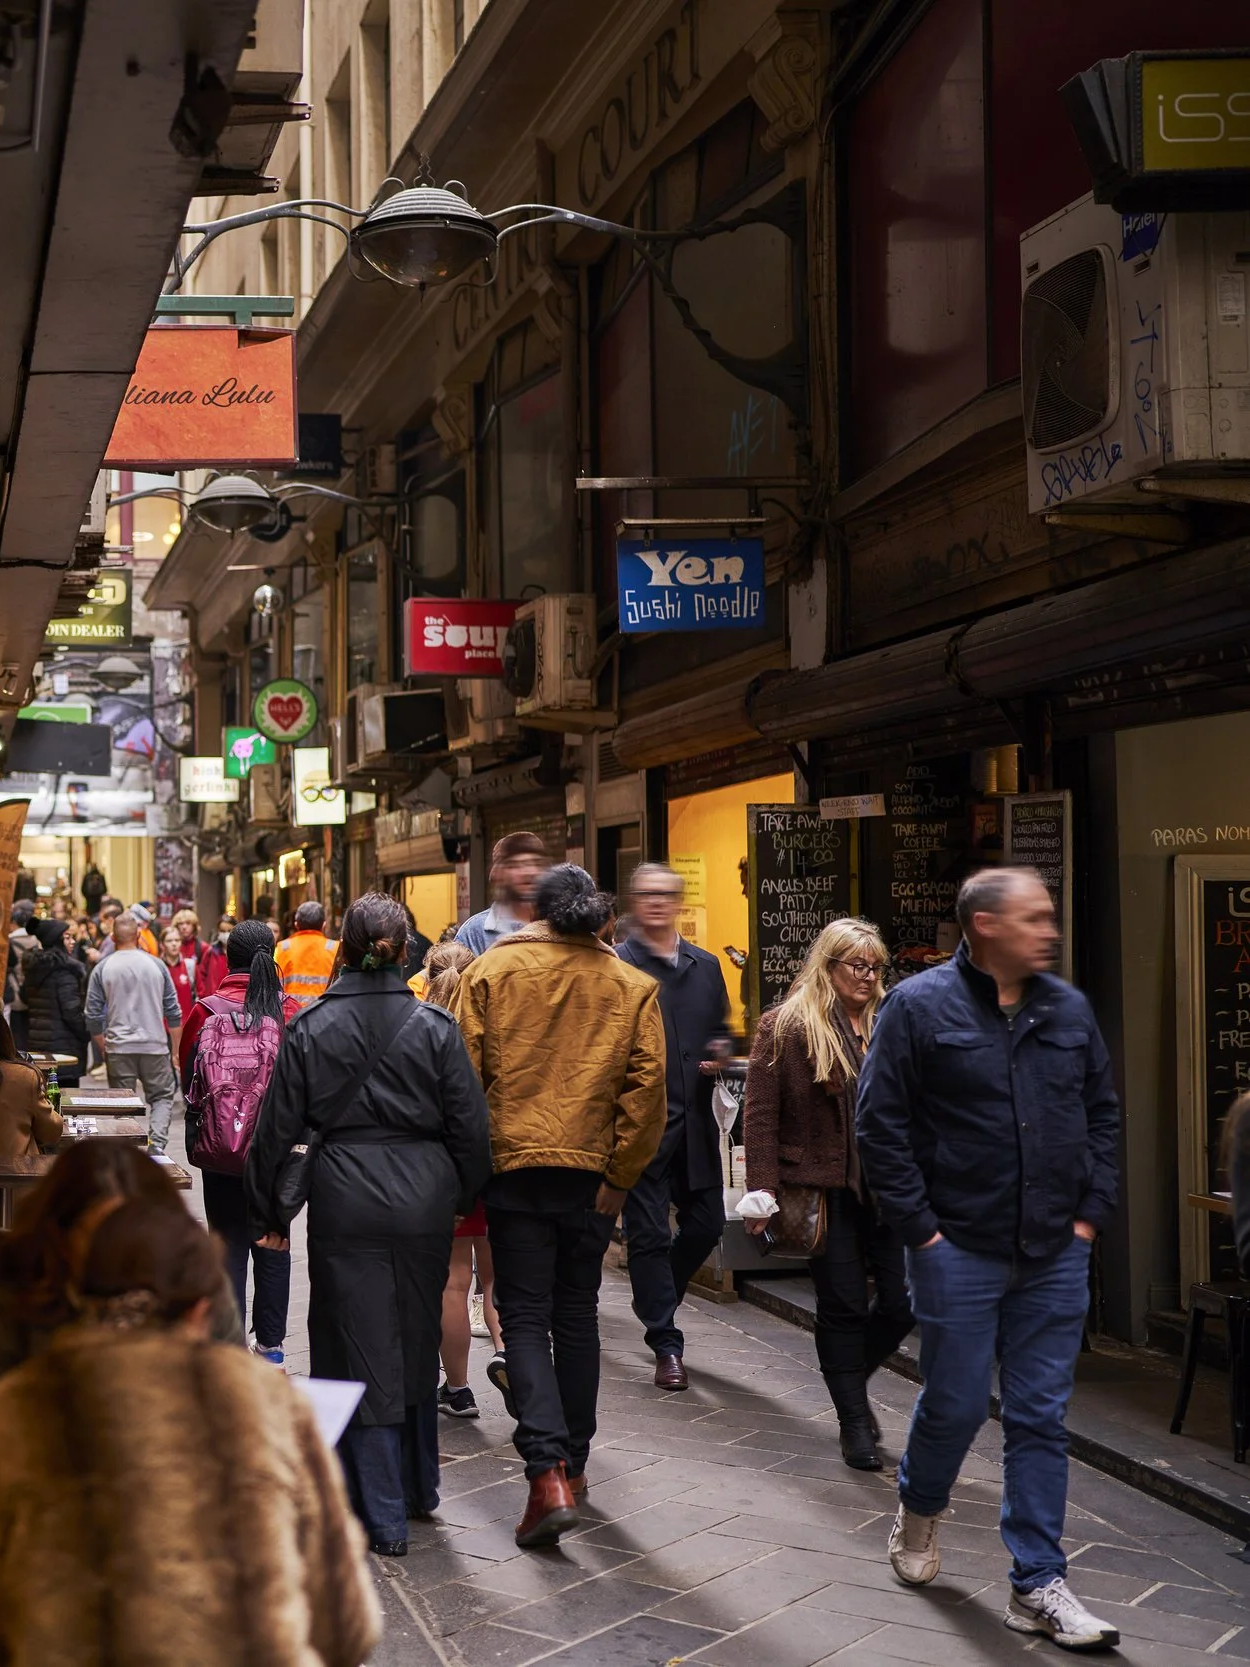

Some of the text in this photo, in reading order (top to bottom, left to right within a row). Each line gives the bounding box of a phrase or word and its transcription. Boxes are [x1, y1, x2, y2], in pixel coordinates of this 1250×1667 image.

[578, 0, 701, 207] COURT
[124, 377, 276, 407] liana Lulu
[635, 550, 745, 586] Yen
[625, 589, 683, 624] Sushi
[424, 615, 445, 625] the
[45, 622, 125, 638] OIN DEALER
[464, 649, 495, 660] place
[772, 831, 841, 850] BURGERS
[903, 836, 940, 849] COFFEE
[1151, 827, 1208, 847] PARAS
[760, 875, 838, 895] ANGUS BEEF
[891, 881, 915, 898] EGG
[779, 892, 818, 911] PATTY
[900, 897, 941, 914] MUFFIN
[761, 910, 821, 928] SOUTHERN
[779, 926, 824, 943] CHICKE
[897, 928, 936, 941] COFFE
[762, 959, 786, 973] EGG
